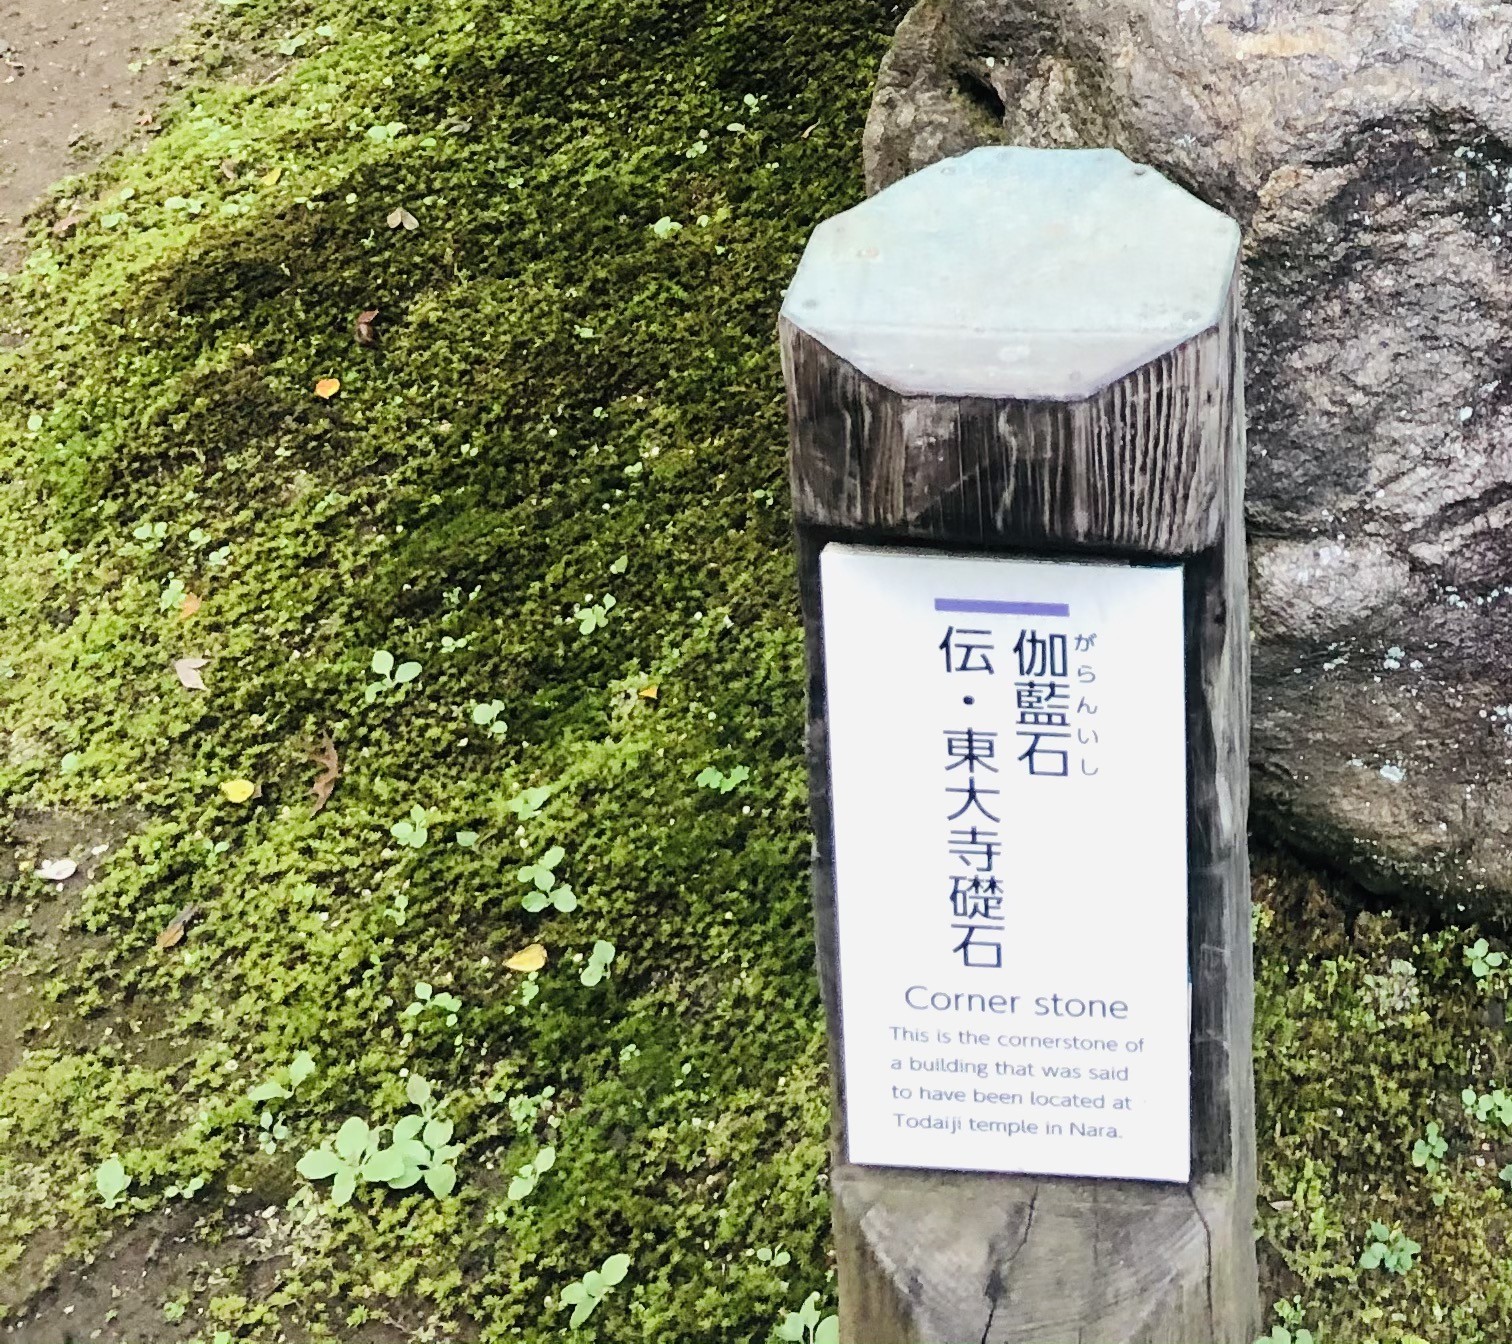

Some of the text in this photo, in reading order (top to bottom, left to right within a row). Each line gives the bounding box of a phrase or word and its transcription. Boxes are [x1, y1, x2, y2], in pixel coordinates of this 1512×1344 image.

[1013, 629, 1071, 777] 伽藍石
[1074, 633, 1099, 776] がらんいし
[939, 625, 1004, 968] 伝・東大寺礎石
[905, 985, 1129, 1020] Corner stone
[889, 1026, 1144, 1053] This is the cornerstone of
[891, 1056, 1129, 1081] a building that was said
[892, 1085, 1132, 1110] to have been located at
[893, 1113, 1122, 1139] Todaiji temple in Nara.
